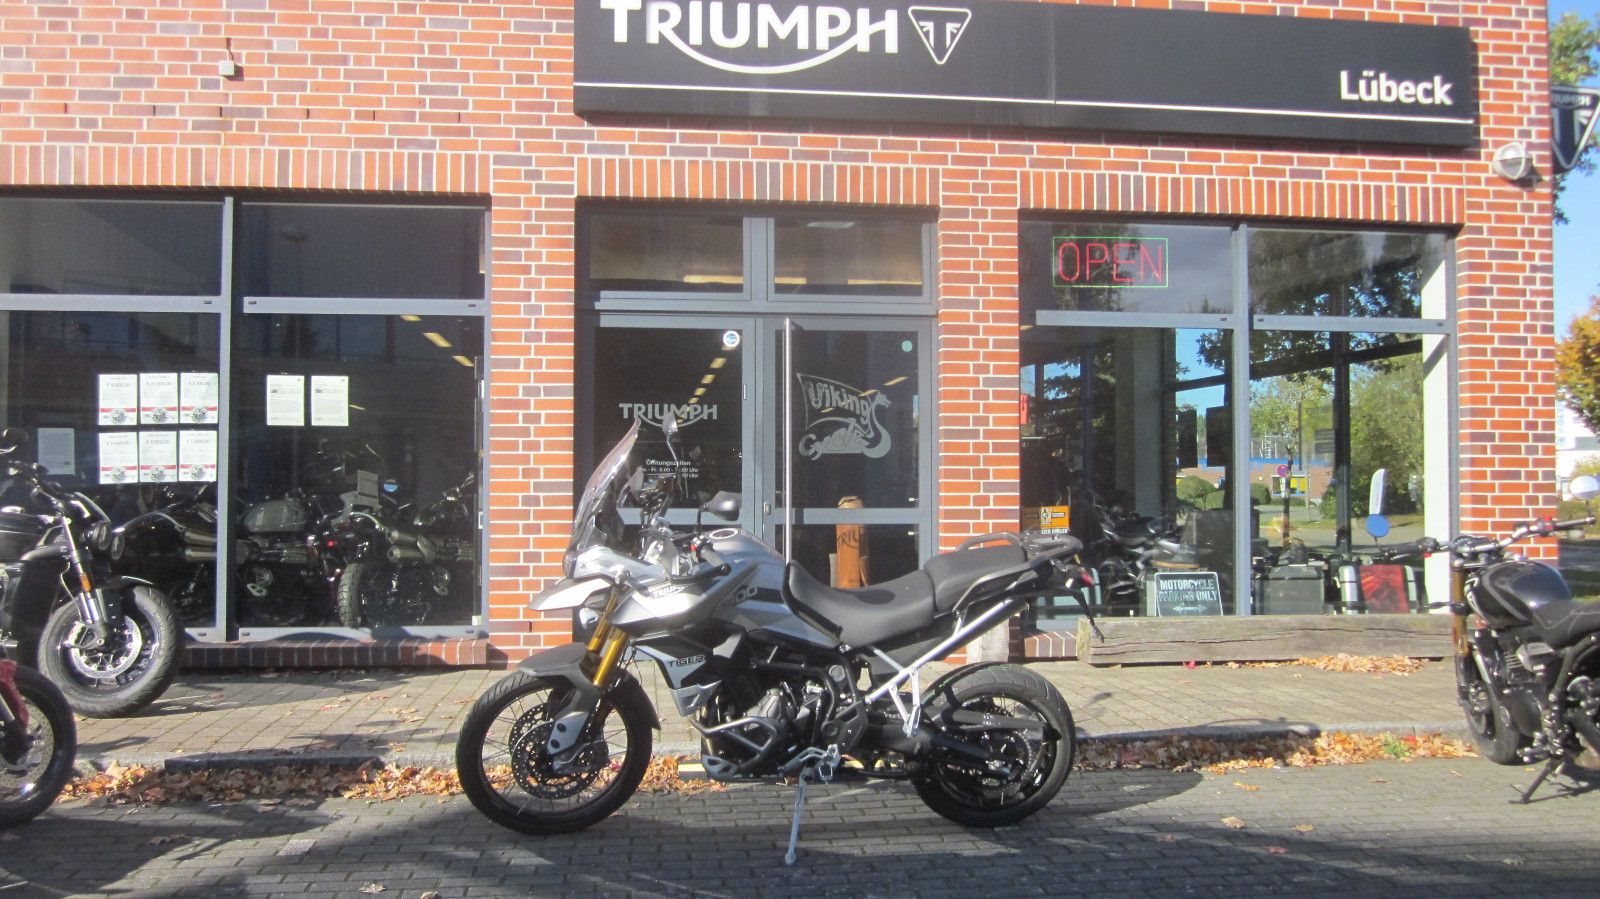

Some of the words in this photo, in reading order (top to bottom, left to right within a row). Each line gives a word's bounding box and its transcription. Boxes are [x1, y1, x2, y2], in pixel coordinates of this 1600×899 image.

[600, 0, 898, 74] TRIUMPH
[1340, 70, 1453, 106] Lübeck
[1058, 241, 1164, 282] OPEN
[619, 403, 718, 428] TRIUMPH
[806, 381, 870, 425] Viking
[645, 459, 691, 467] Öffnungsziten
[1160, 579, 1215, 590] MOTORCYCLE
[1196, 590, 1218, 601] ONLY
[667, 654, 706, 668] TIGER
